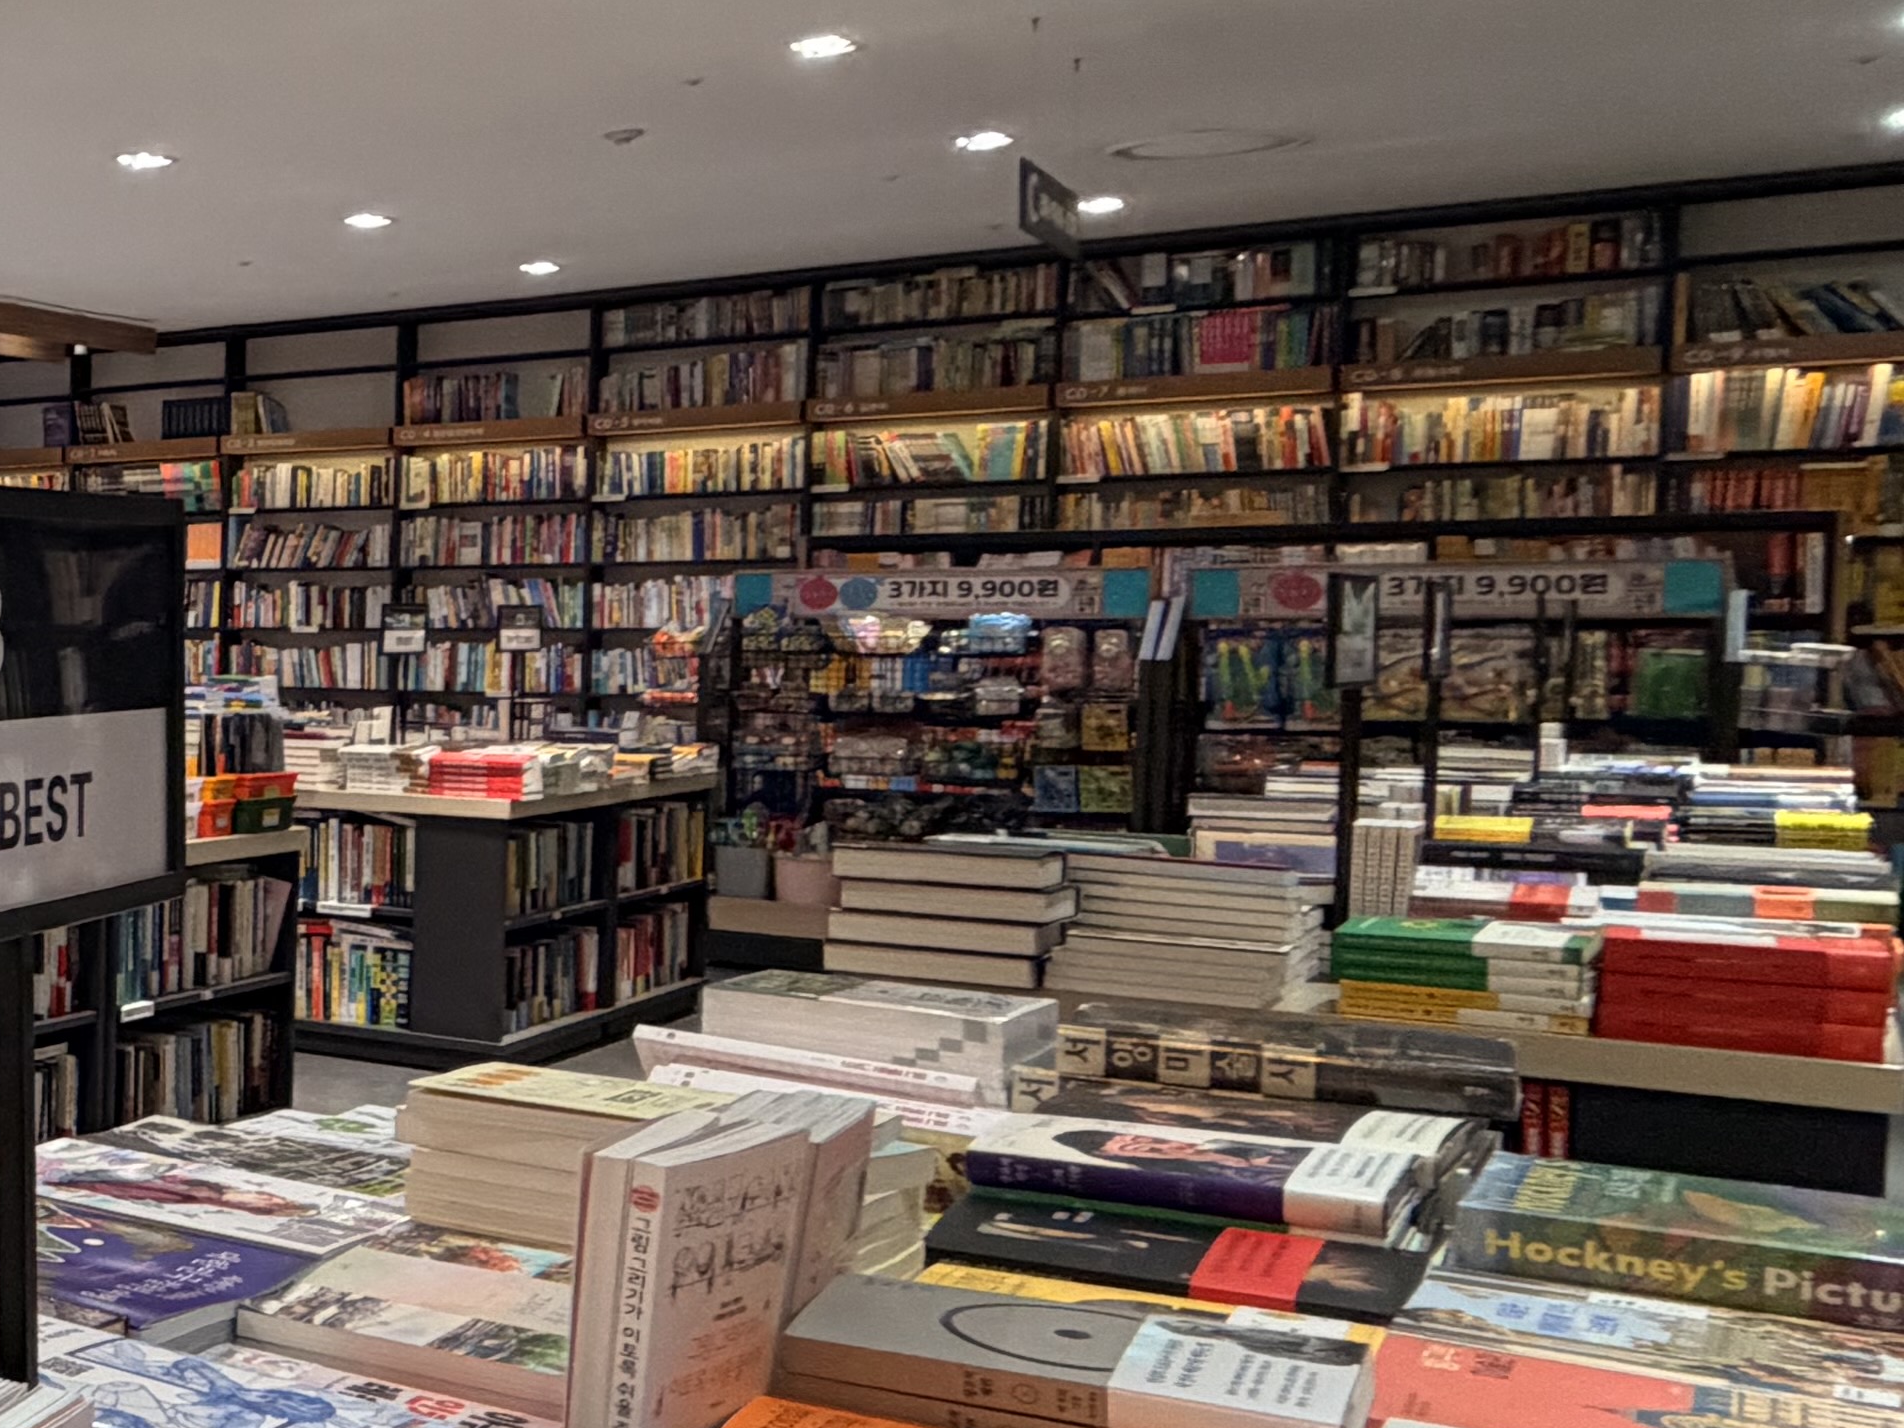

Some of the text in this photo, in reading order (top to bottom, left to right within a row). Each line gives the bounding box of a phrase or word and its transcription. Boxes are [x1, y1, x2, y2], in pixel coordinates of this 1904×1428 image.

[887, 577, 1059, 602] 3가지 9,900원
[1475, 573, 1609, 596] 9,900원
[632, 1216, 651, 1256] 그림
[1484, 1227, 1749, 1292] Hockney's
[622, 1257, 650, 1321] 그리기가
